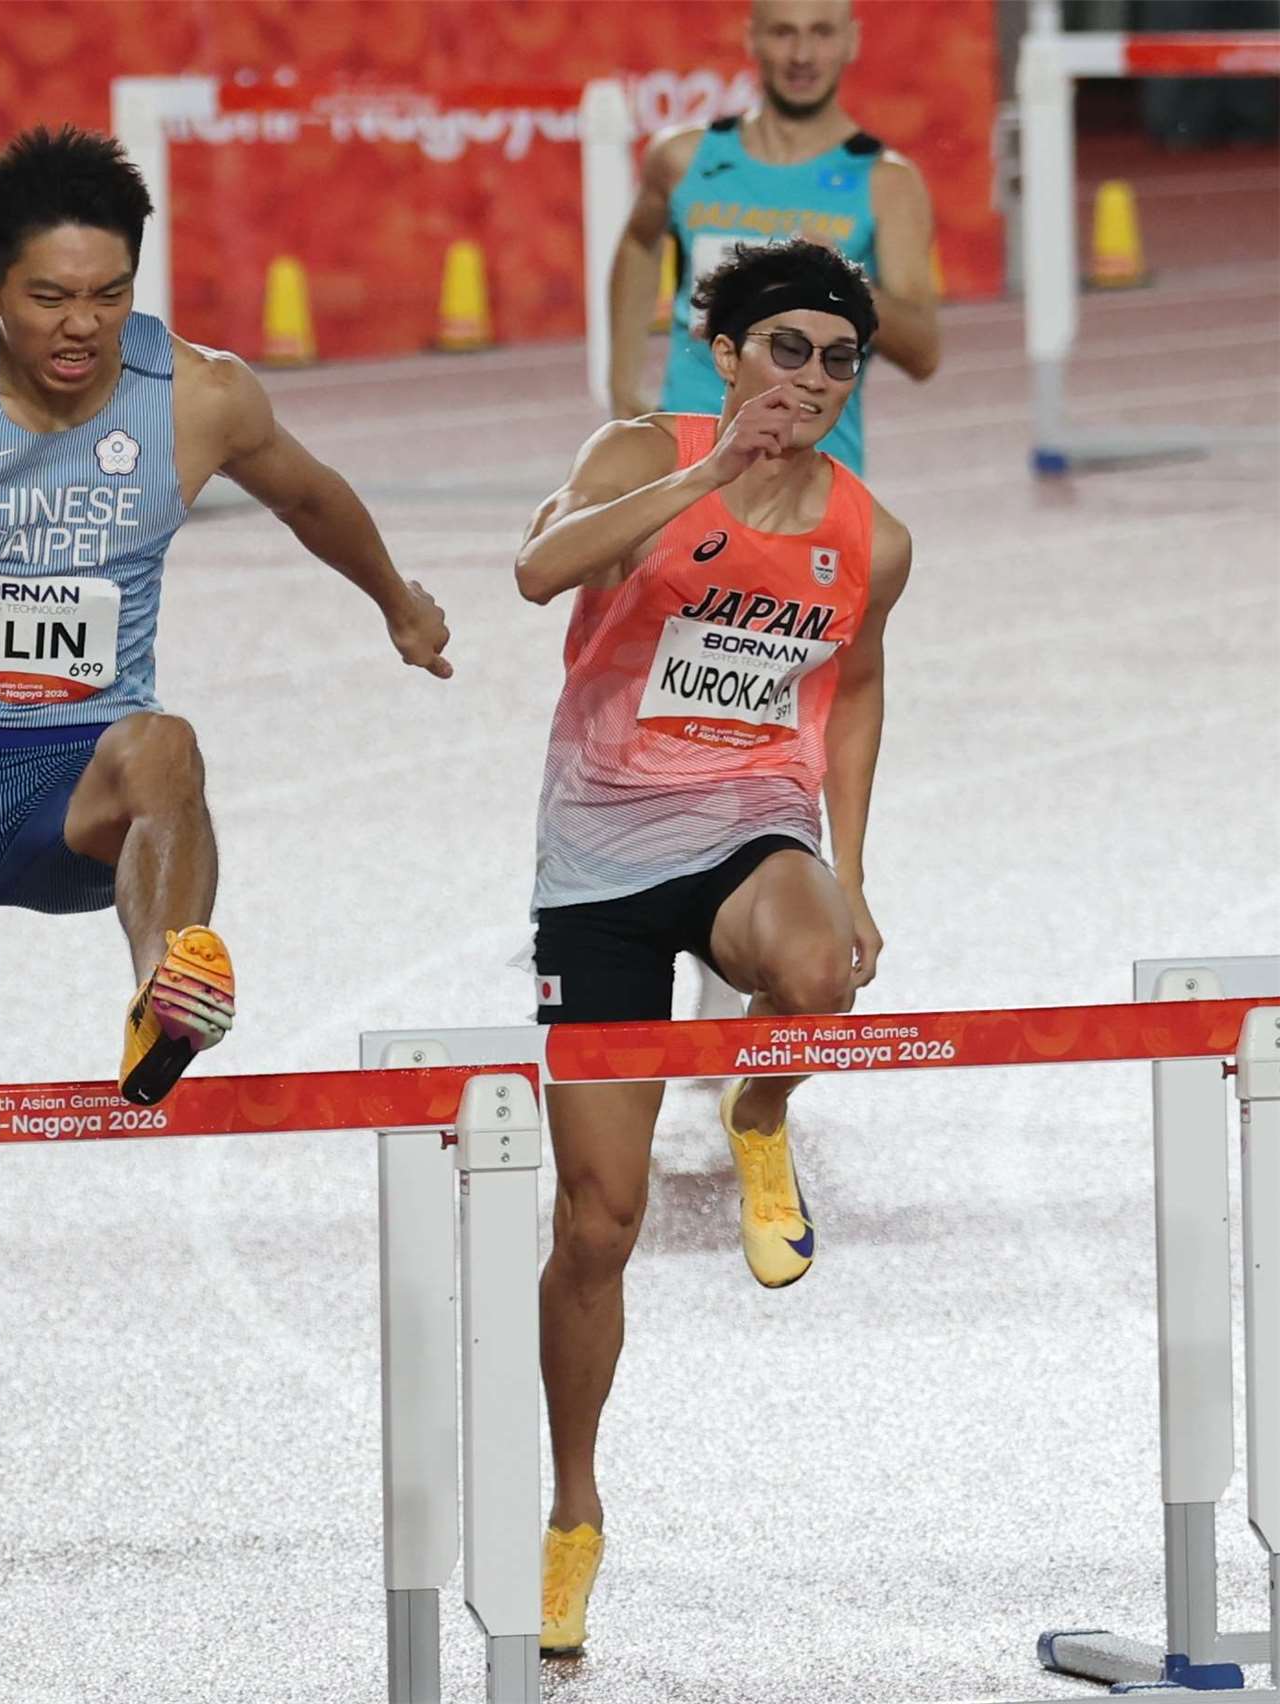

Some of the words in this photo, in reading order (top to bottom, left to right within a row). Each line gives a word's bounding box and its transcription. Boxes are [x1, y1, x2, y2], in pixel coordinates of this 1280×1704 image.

[681, 587, 835, 640] JAPAN
[702, 632, 809, 664] BORNAN
[68, 662, 104, 677] 699
[660, 657, 791, 712] KUROKA
[770, 1028, 808, 1043] 20th
[812, 1026, 857, 1042] Asian
[861, 1026, 919, 1040] Games
[734, 1044, 892, 1069] Aichi-Nagoya
[898, 1040, 956, 1061] 2026
[20, 1095, 66, 1111] Asian
[70, 1094, 130, 1109] Games
[108, 1110, 168, 1130] 2026
